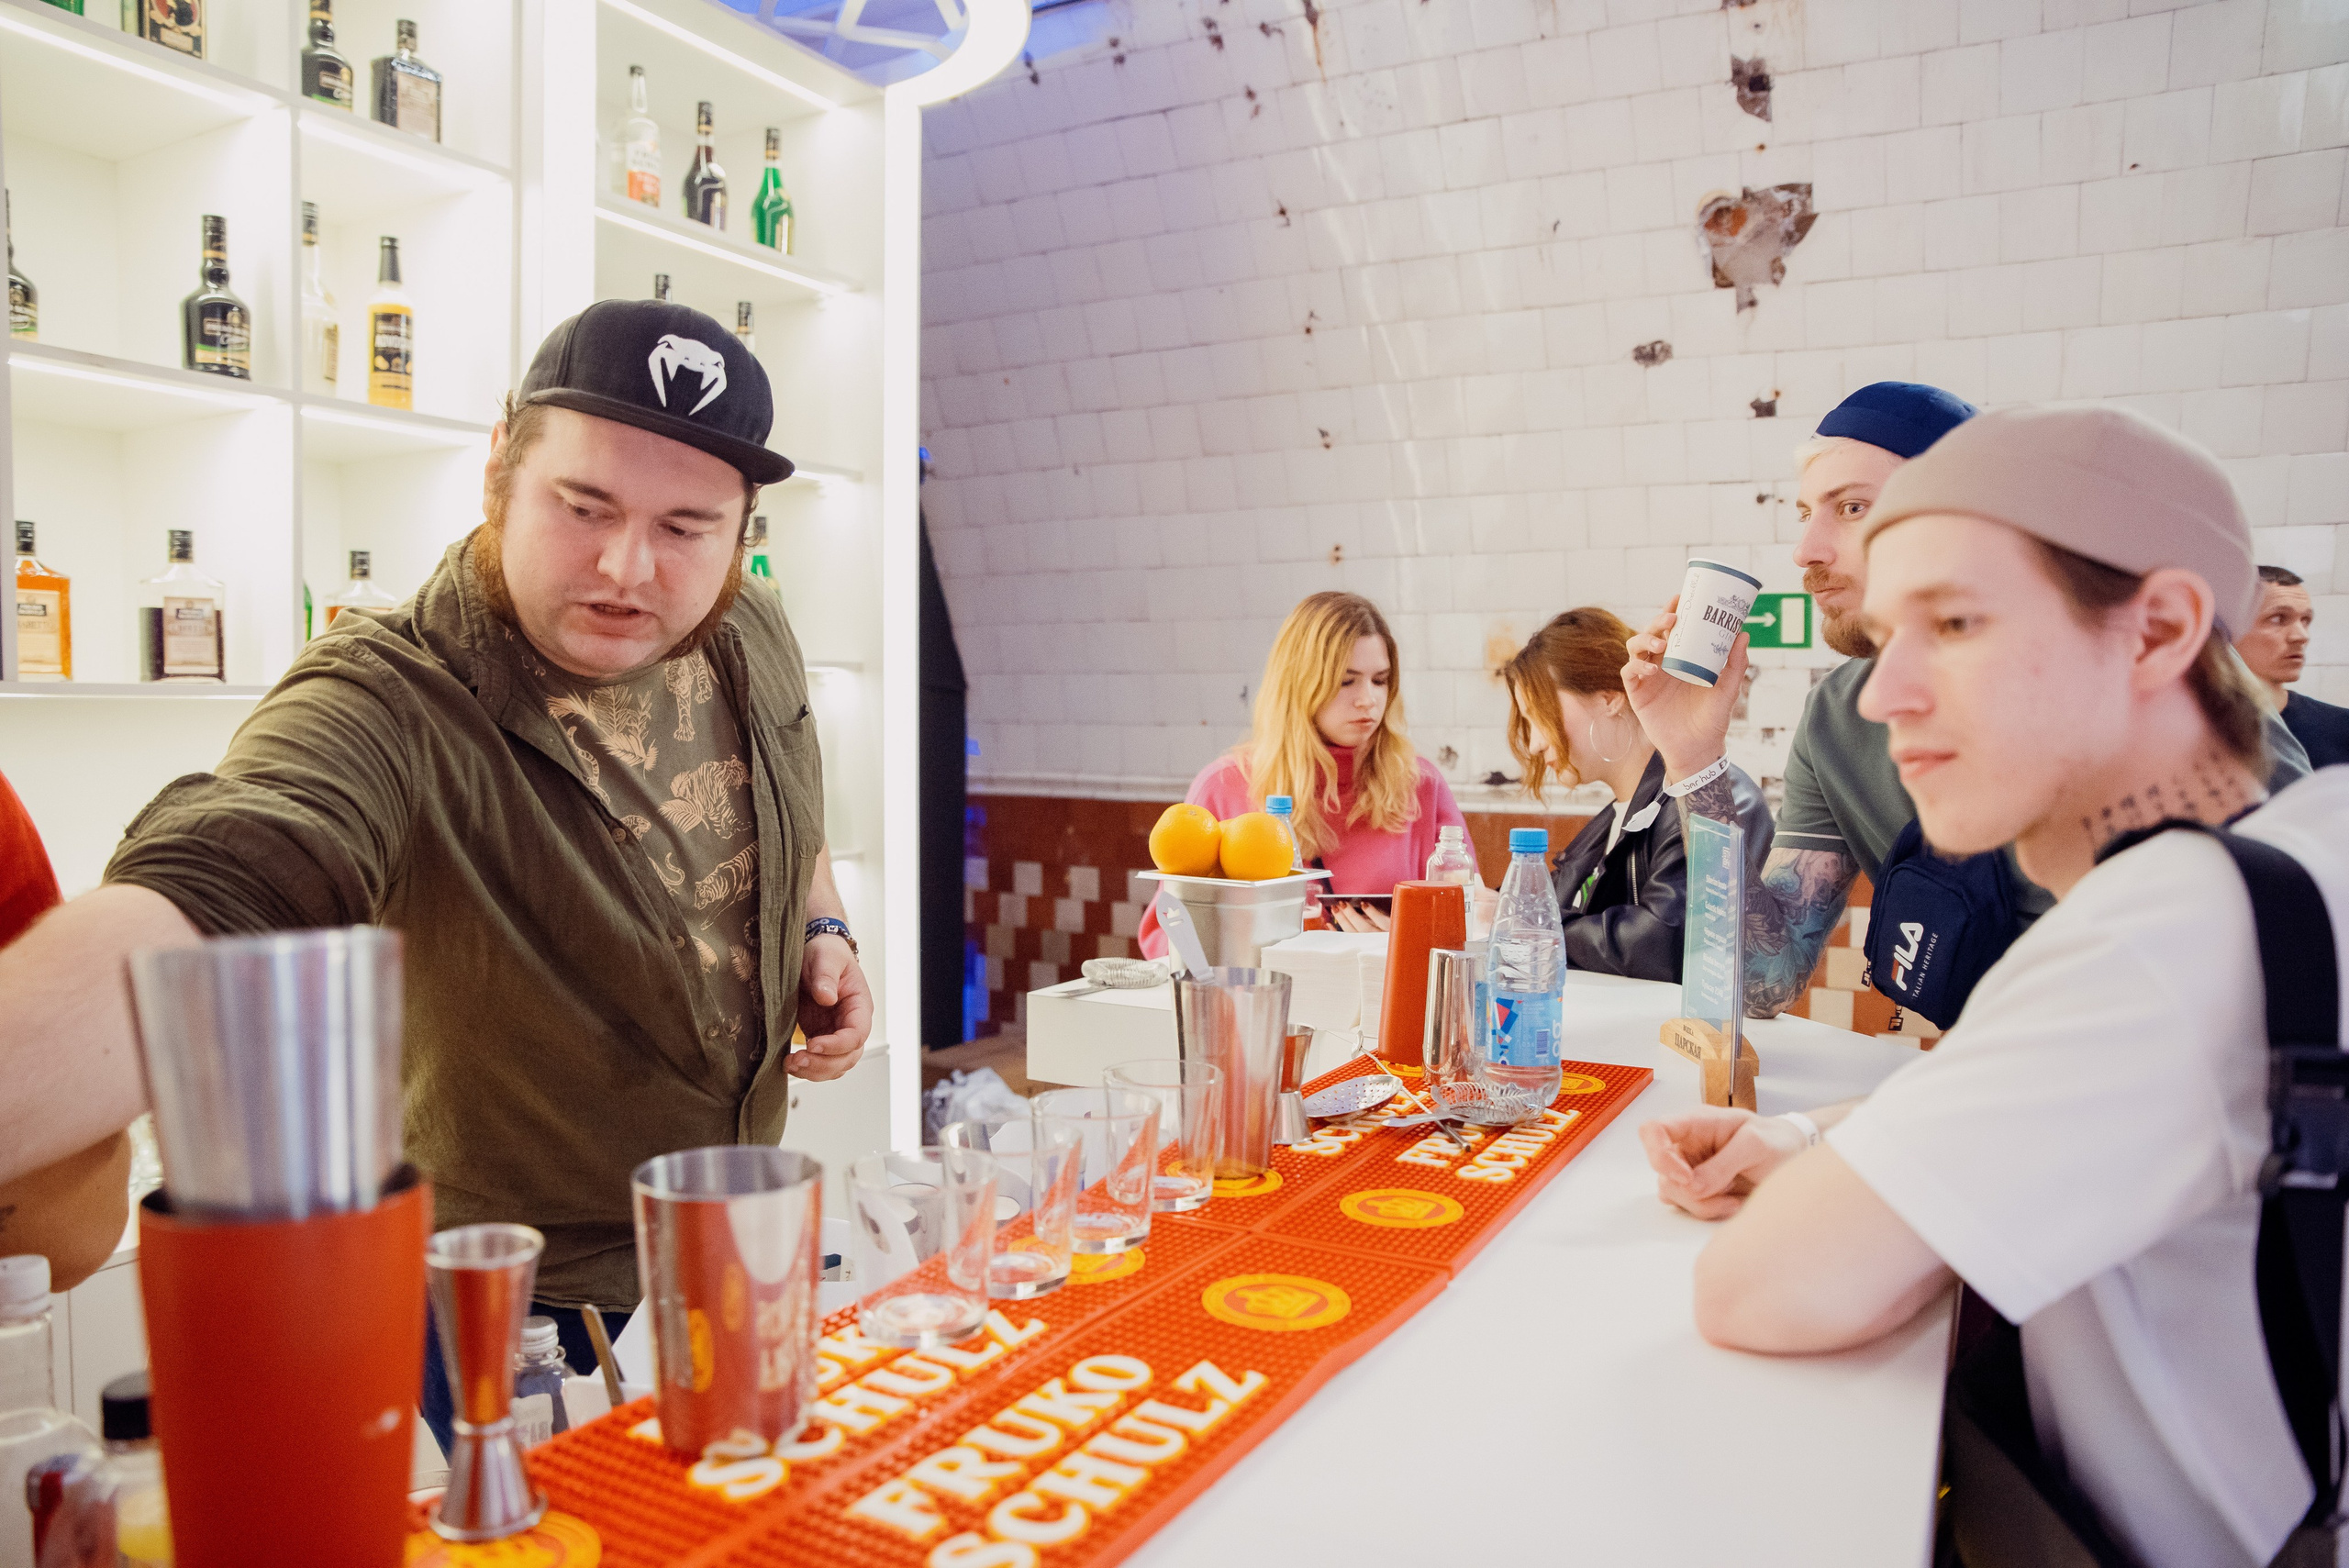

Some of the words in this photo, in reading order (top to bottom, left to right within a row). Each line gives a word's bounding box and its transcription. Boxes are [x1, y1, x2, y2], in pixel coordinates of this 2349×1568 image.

[1718, 629, 1735, 642] GIN
[1683, 780, 1698, 791] bar
[1699, 770, 1717, 784] hub
[1891, 923, 1924, 991] FILA
[1911, 972, 1926, 999] TALIAN
[1922, 932, 1939, 971] HERITAGE
[1675, 1032, 1702, 1060] ЦАРСКАЯ
[845, 1354, 1153, 1539] FRUKO
